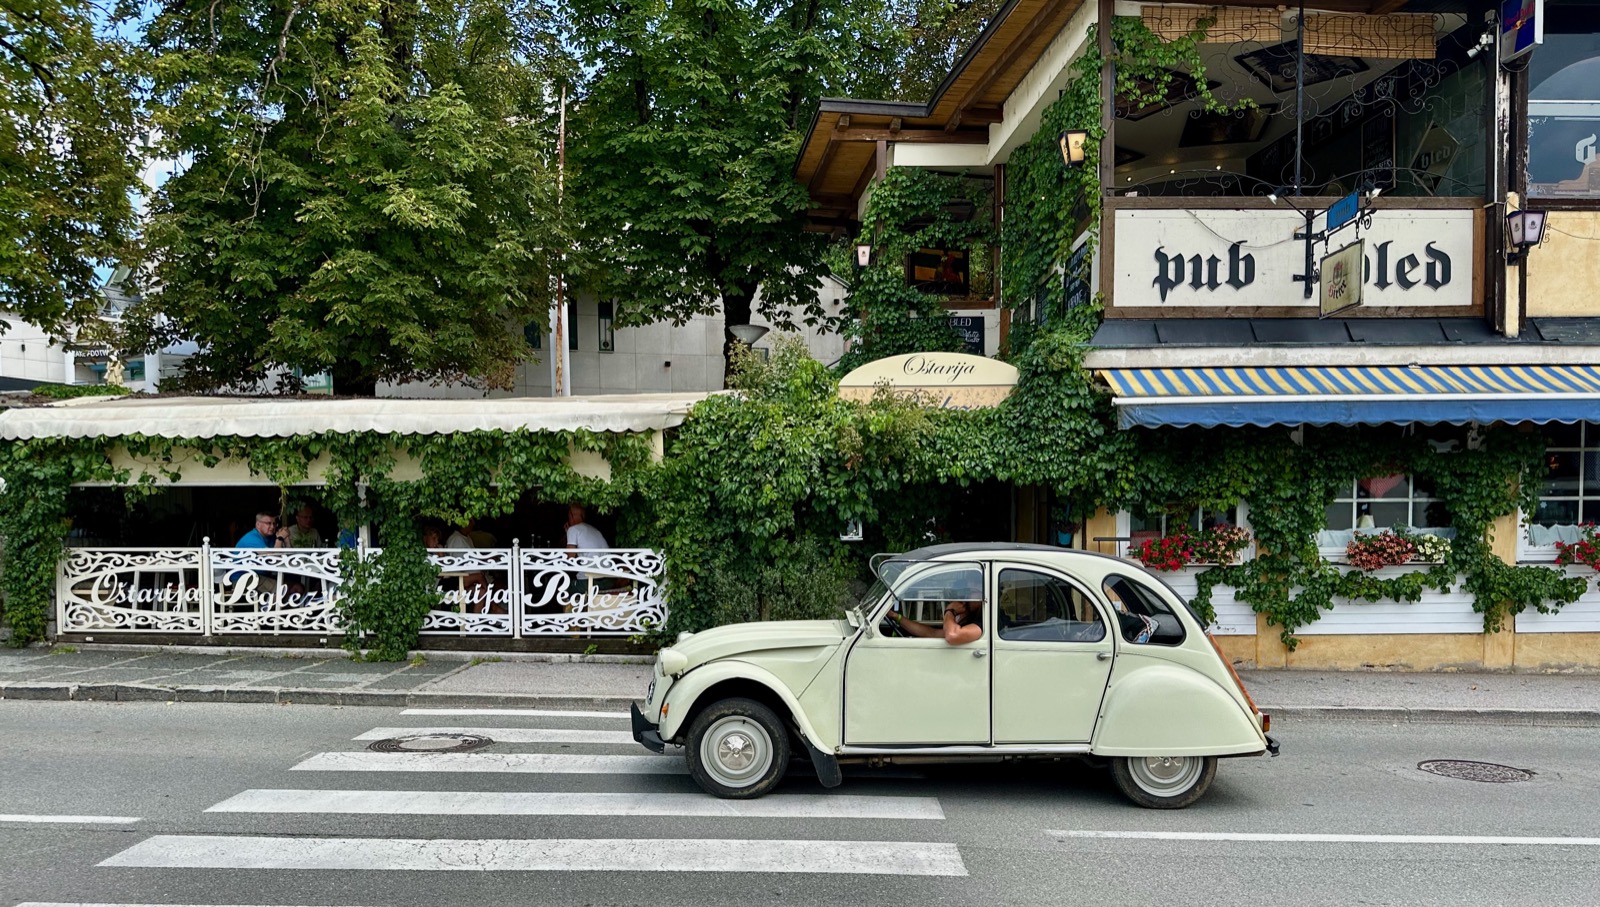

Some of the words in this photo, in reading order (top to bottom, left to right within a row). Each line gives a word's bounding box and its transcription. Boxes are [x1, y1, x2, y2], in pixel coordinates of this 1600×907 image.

[1152, 240, 1256, 303] pub
[903, 355, 976, 383] Oštarija
[91, 572, 203, 613] Oštarija
